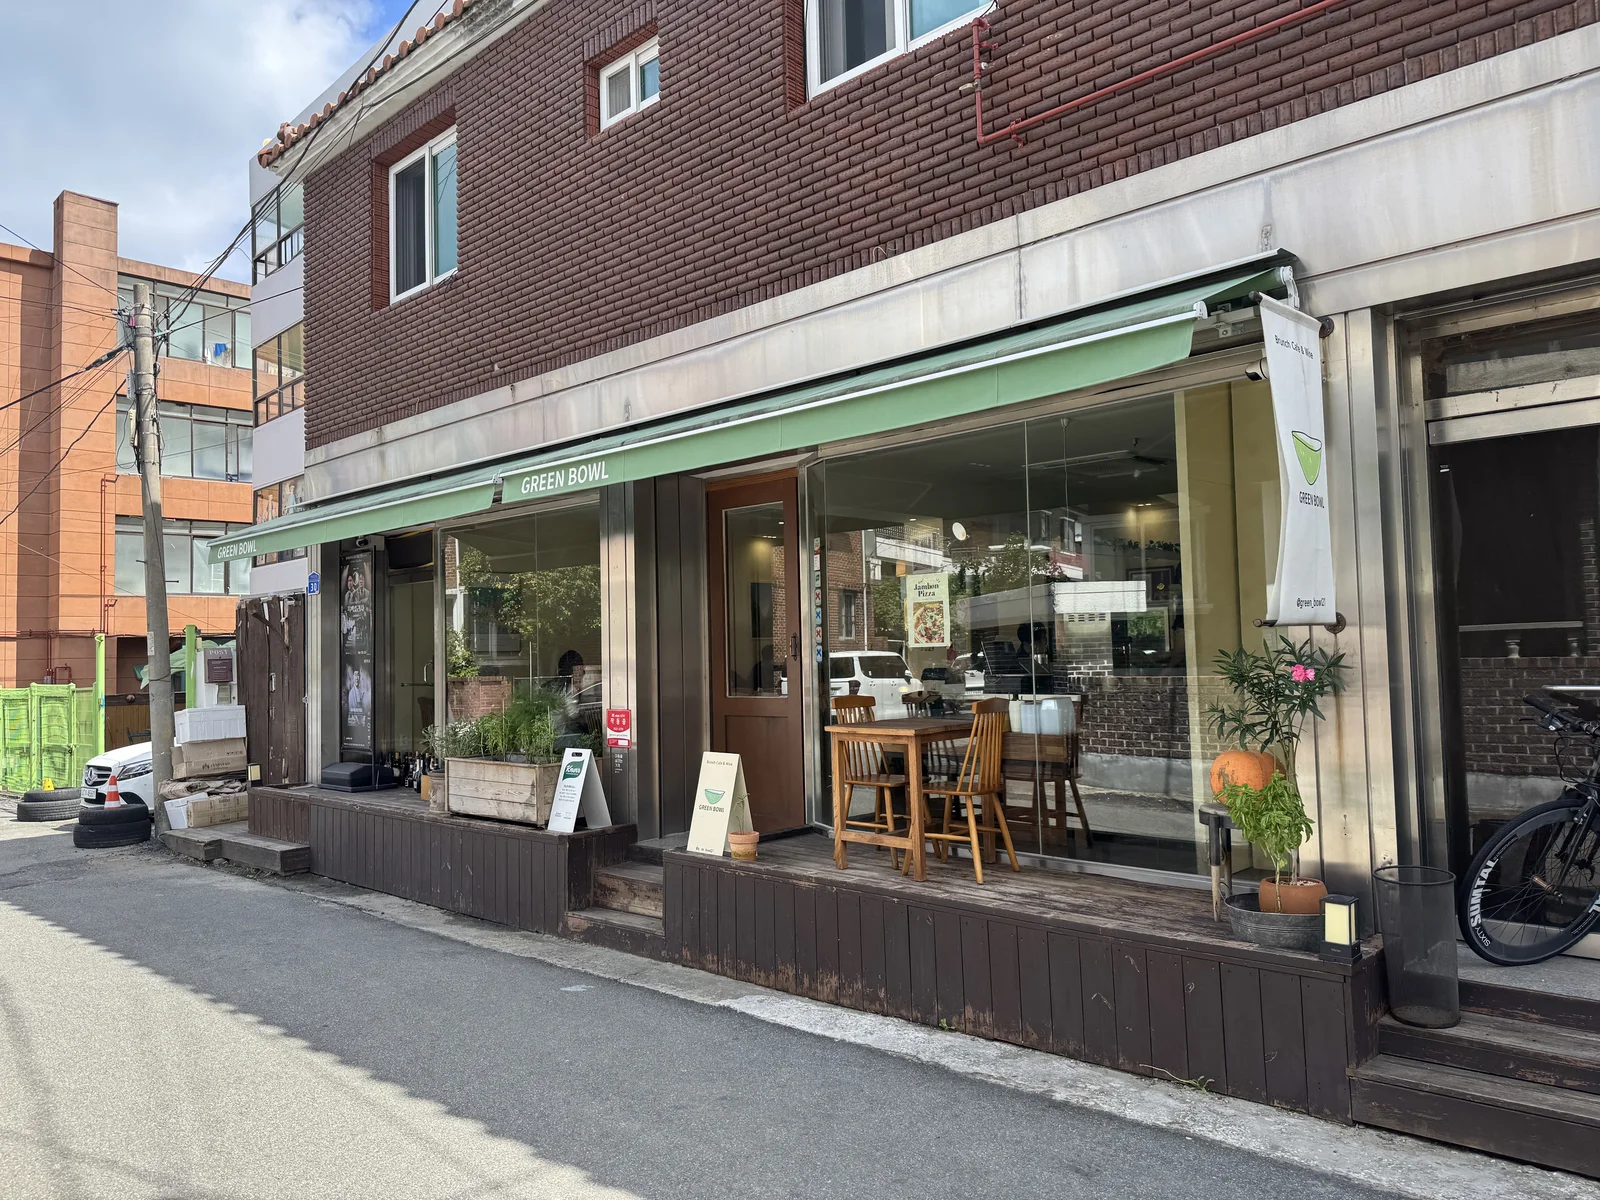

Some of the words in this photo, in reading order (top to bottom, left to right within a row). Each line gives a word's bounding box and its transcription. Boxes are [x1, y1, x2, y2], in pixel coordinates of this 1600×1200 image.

[1300, 345, 1305, 355] &
[521, 469, 565, 494] GREEN
[568, 461, 609, 486] BOWL
[1299, 491, 1314, 506] GREEN
[1313, 494, 1325, 509] BOWL
[217, 543, 238, 559] GREEN
[238, 540, 257, 555] BOWL
[914, 583, 940, 591] Jambon
[918, 589, 936, 597] Pizza
[1470, 859, 1499, 928] SUMTAL
[1474, 926, 1491, 947] SIXTY
